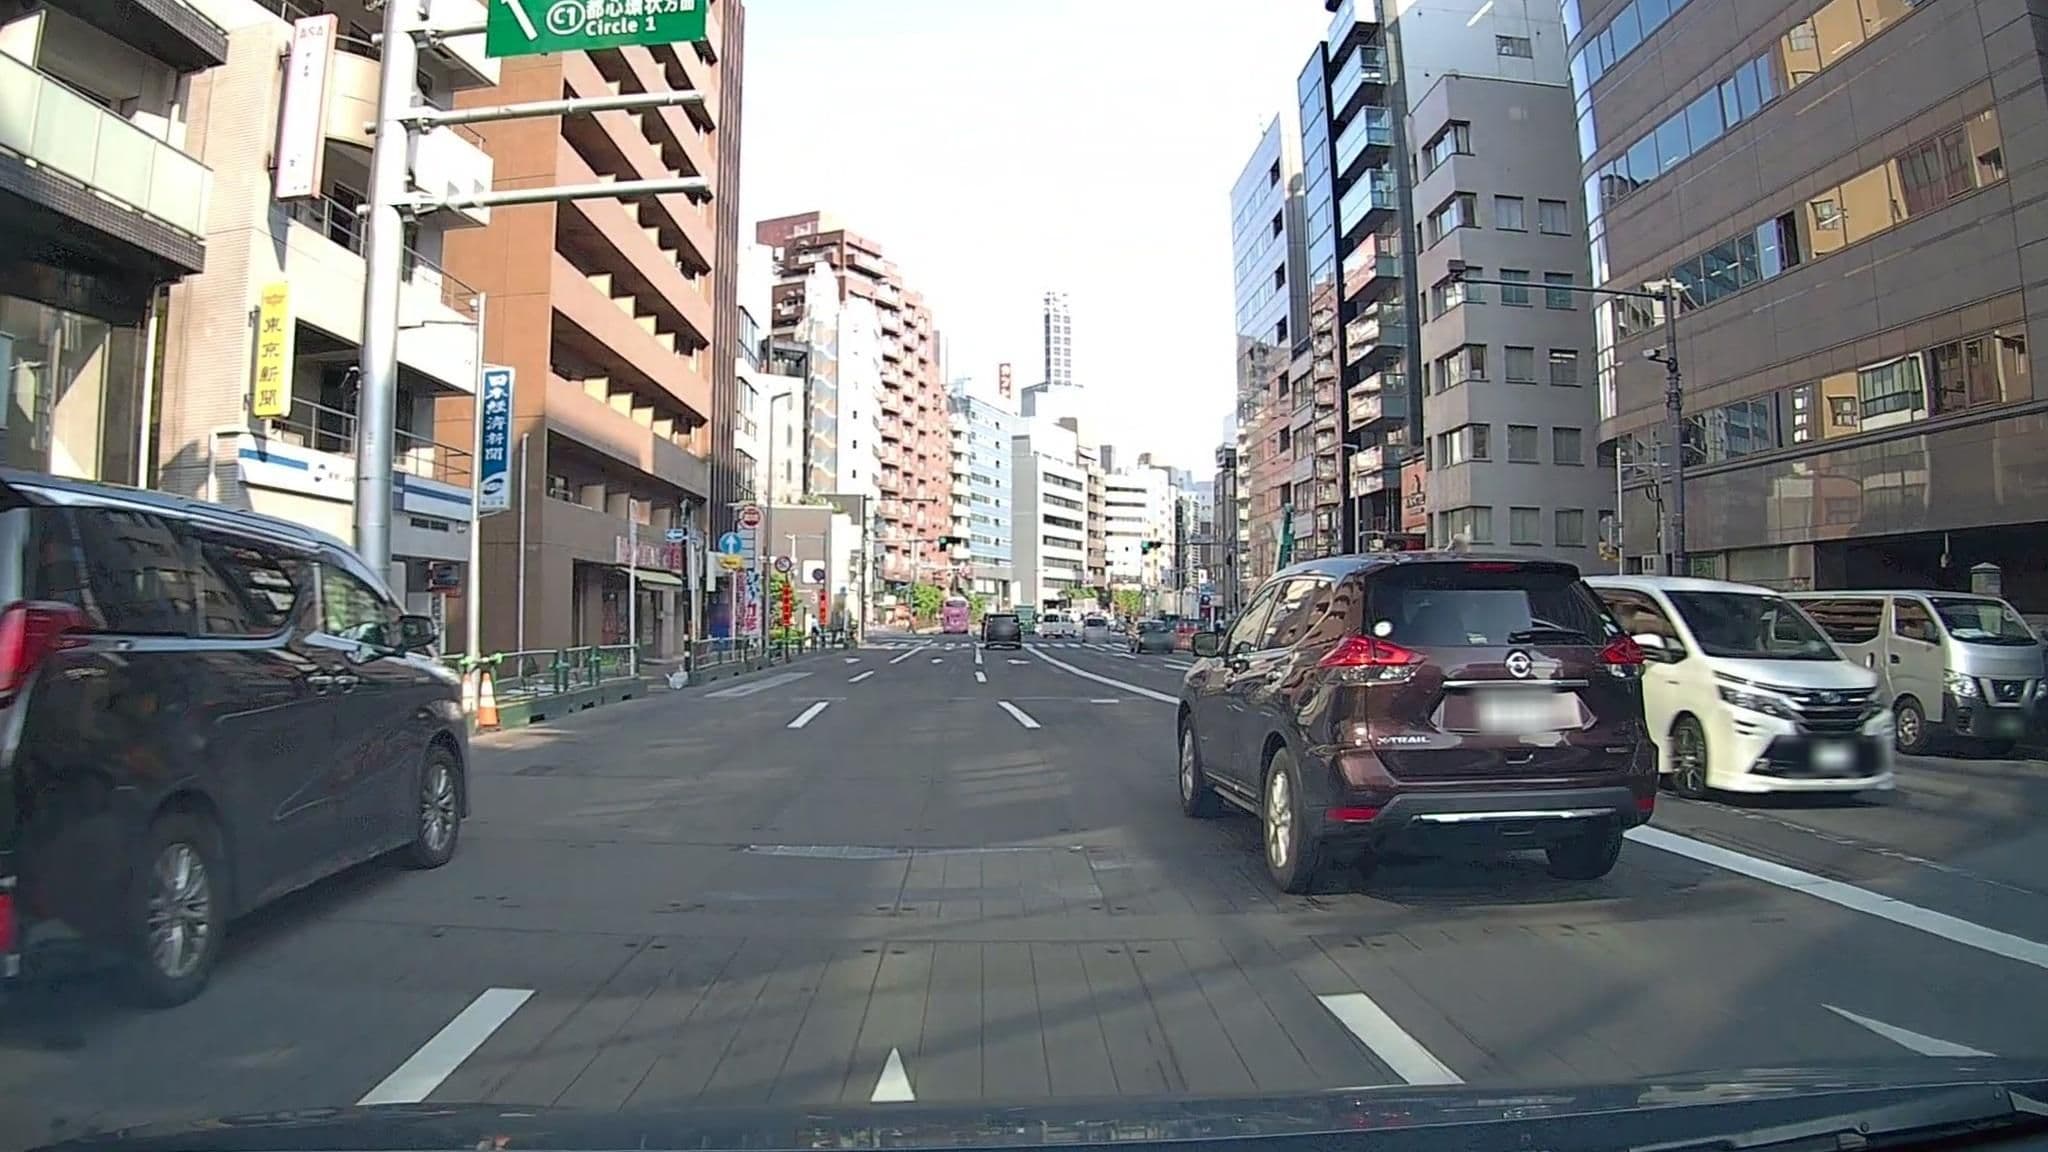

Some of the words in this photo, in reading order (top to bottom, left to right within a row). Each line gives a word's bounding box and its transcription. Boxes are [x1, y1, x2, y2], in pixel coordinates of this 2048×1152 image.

[552, 6, 577, 27] C1
[585, 17, 638, 37] Circle
[645, 16, 657, 31] 1
[258, 317, 282, 407] 東京新聞
[485, 373, 508, 461] 日本経済新聞
[1376, 735, 1432, 746] X-TRAIL
